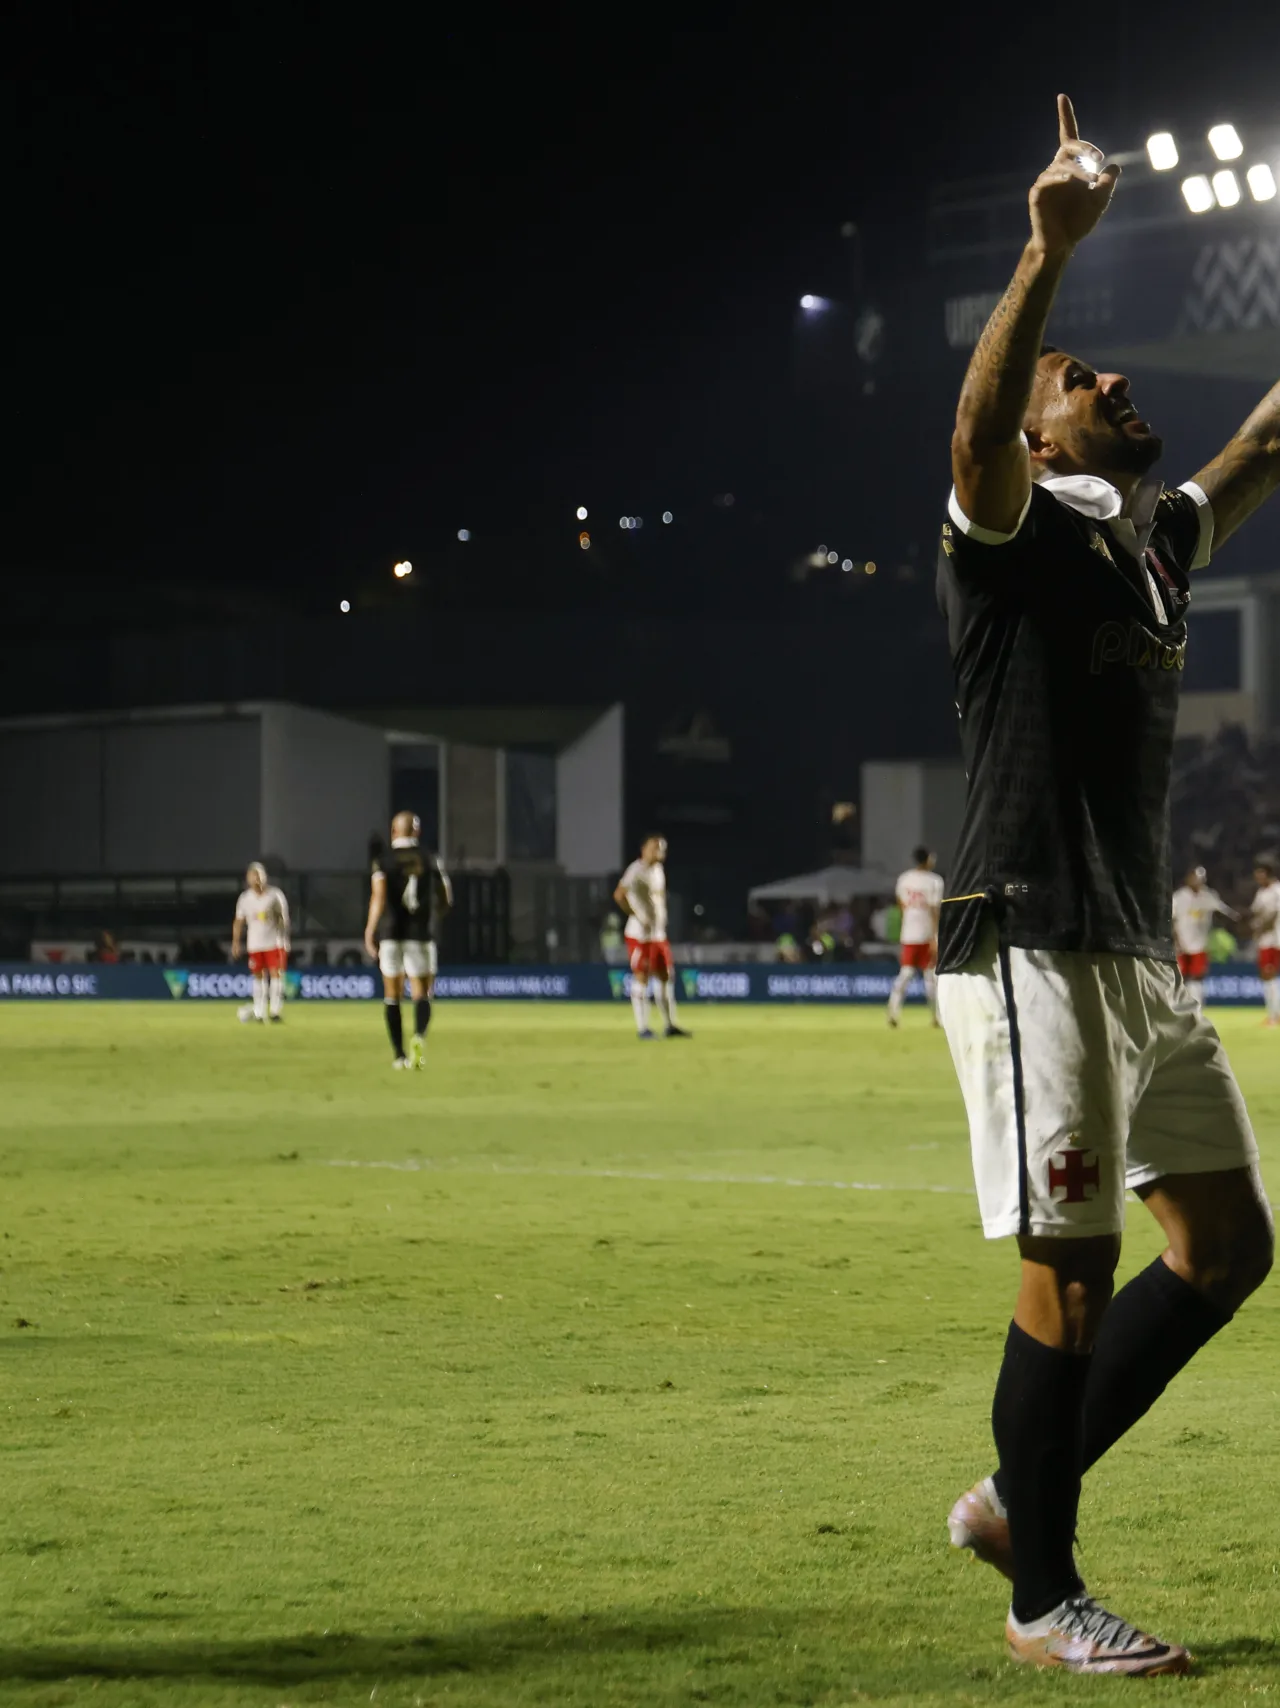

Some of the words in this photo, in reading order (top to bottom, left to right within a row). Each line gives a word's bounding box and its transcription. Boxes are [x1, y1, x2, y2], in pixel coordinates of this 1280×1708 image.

[12, 973, 55, 995] PARA
[56, 973, 71, 995] O
[300, 975, 375, 999] SICOOB
